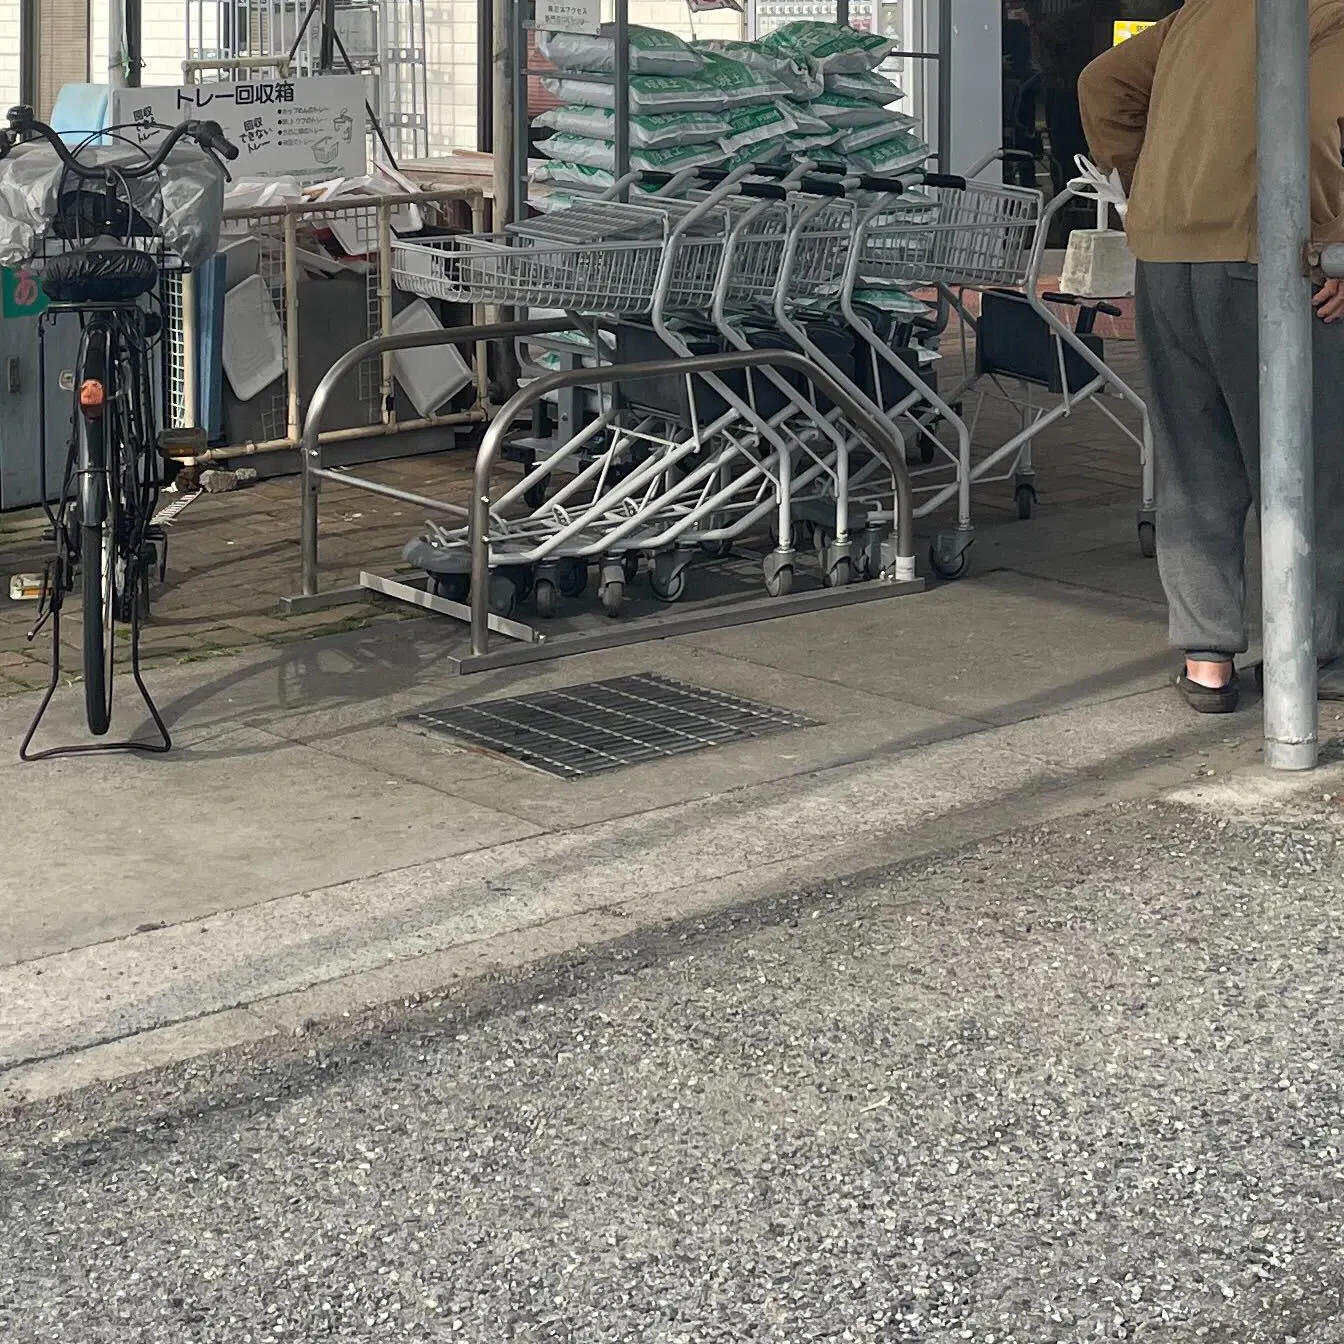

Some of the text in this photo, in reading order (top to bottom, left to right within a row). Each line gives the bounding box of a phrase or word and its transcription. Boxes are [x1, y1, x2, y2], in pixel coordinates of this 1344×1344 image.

[176, 82, 295, 110] トレー回収箱
[244, 117, 263, 132] 回収
[247, 141, 271, 154] トレー
